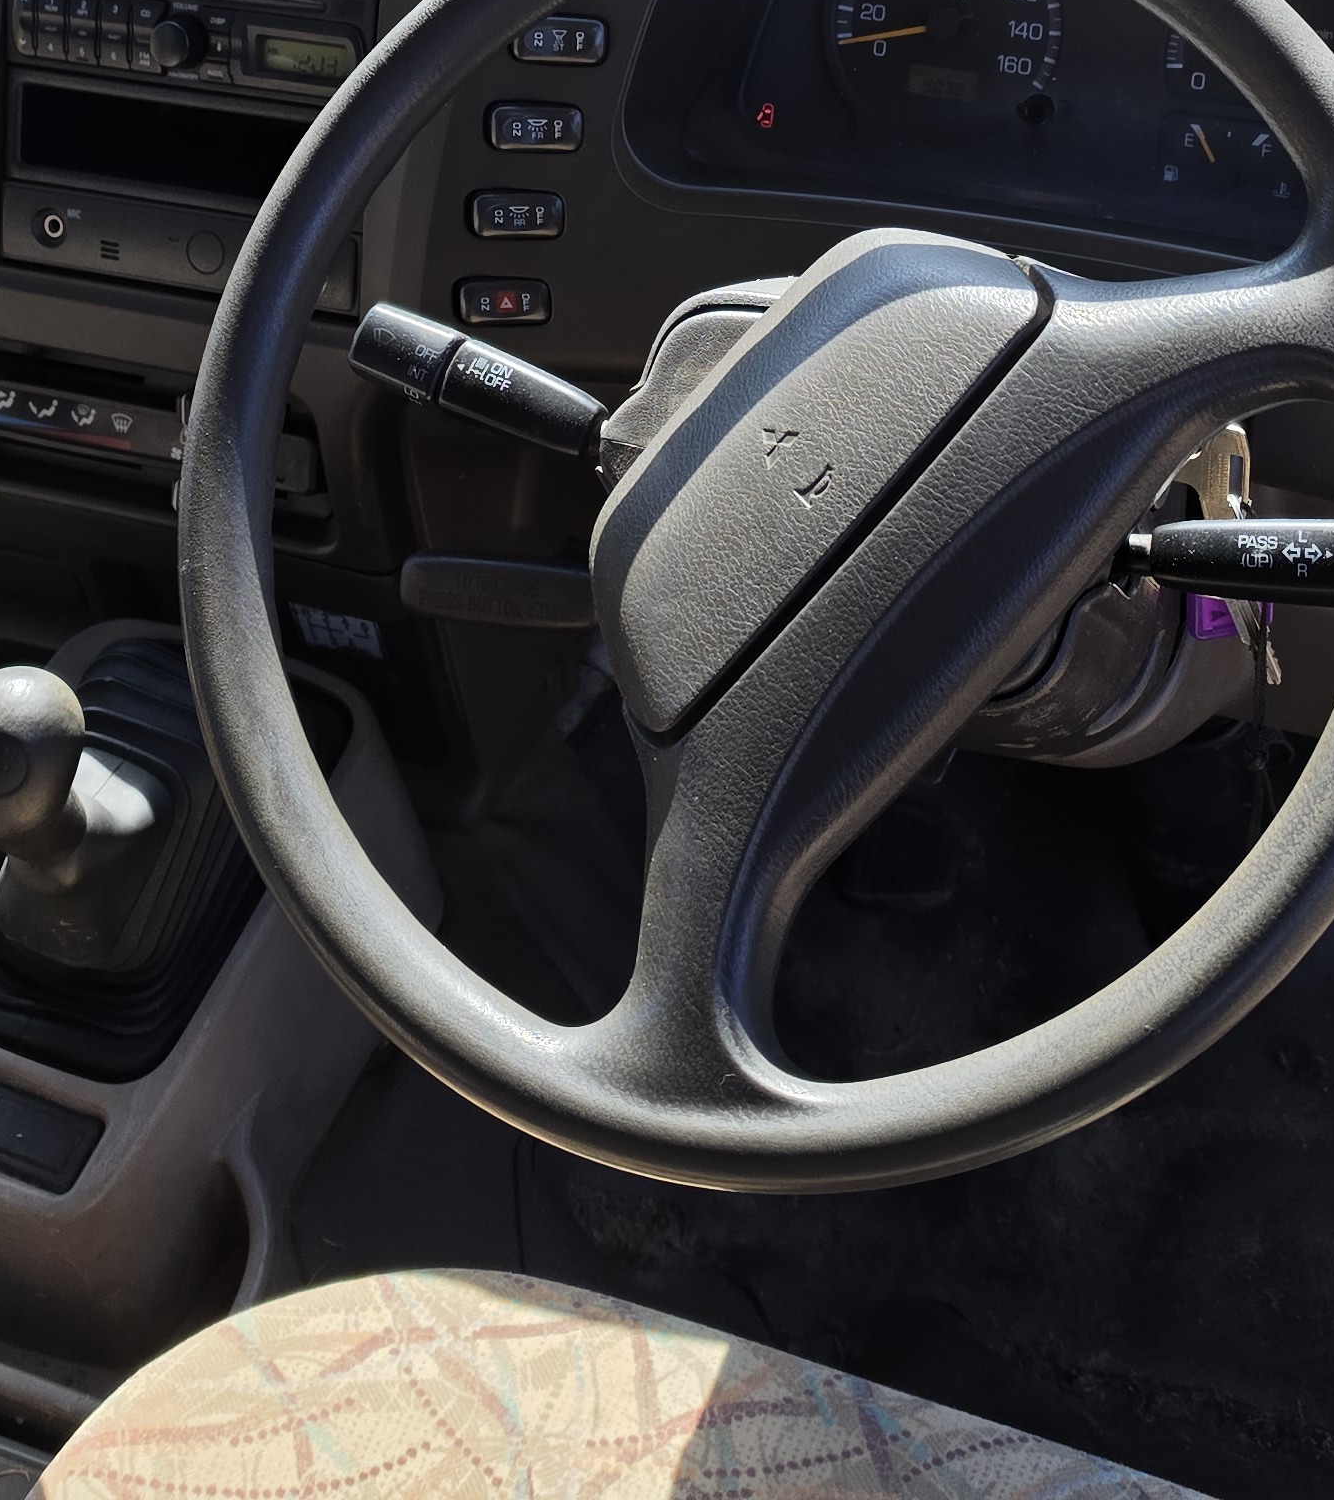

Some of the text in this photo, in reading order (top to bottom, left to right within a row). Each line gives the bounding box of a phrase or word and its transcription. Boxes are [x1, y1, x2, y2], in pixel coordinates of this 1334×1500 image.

[860, 3, 886, 22] 20
[1008, 20, 1043, 41] 140
[533, 32, 544, 47] ON
[553, 43, 565, 52] ST
[576, 31, 585, 51] OFF
[873, 40, 887, 57] 0
[997, 54, 1032, 75] 160
[1190, 71, 1206, 90] 0
[512, 122, 522, 137] ON
[531, 131, 544, 140] FR
[553, 120, 563, 139] OFF
[1184, 132, 1195, 148] E
[1261, 143, 1273, 158] F
[495, 209, 504, 224] ON
[514, 217, 526, 227] RR
[536, 206, 545, 225] OFF
[481, 297, 490, 311] ON
[521, 293, 530, 312] OFF
[415, 344, 438, 361] OFF
[407, 364, 429, 382] INT
[490, 362, 514, 379] ON
[484, 374, 512, 392] OFF
[1237, 534, 1279, 551] PASS
[1298, 530, 1308, 544] L
[1241, 552, 1274, 570] (UP)
[1297, 563, 1308, 577] R
